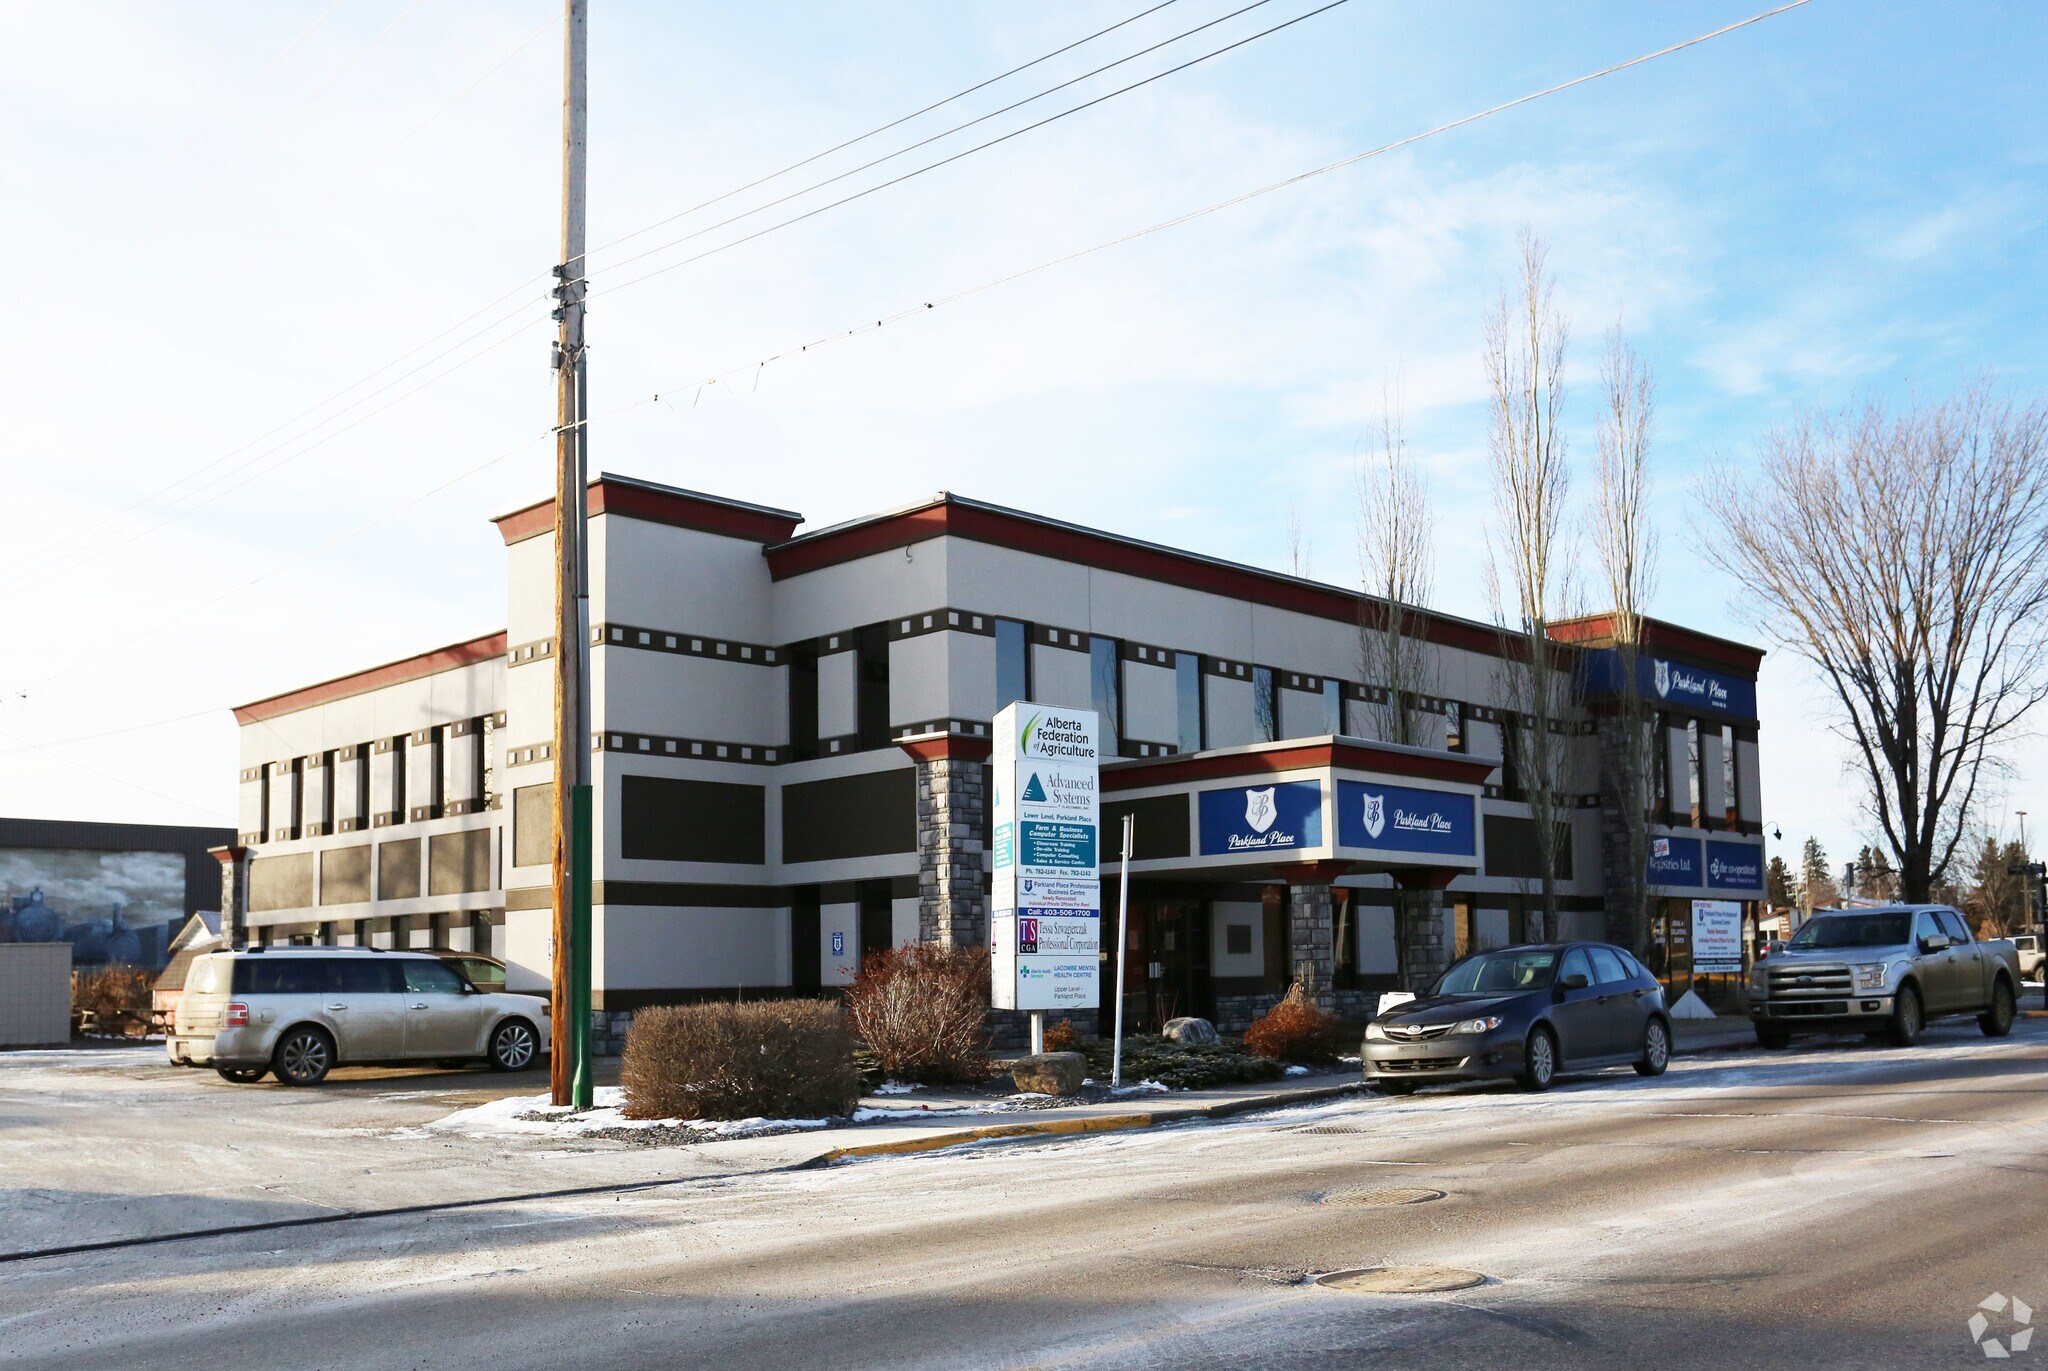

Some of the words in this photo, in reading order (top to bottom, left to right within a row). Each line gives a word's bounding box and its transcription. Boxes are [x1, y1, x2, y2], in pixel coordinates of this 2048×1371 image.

[1046, 717, 1082, 731] Alberta
[1037, 728, 1088, 744] Federation
[1033, 742, 1040, 751] of
[1040, 742, 1095, 757] Agriculture
[1046, 773, 1094, 790] Advanced
[1053, 789, 1090, 806] Systems
[1394, 809, 1430, 829] Parkland
[1430, 813, 1451, 830] Place
[1228, 834, 1269, 849] Parkland
[1269, 831, 1294, 847] Place
[1039, 921, 1053, 934] Tessa
[1021, 944, 1036, 952] CGA
[1039, 937, 1068, 950] Professional
[1070, 938, 1098, 953] Corporation
